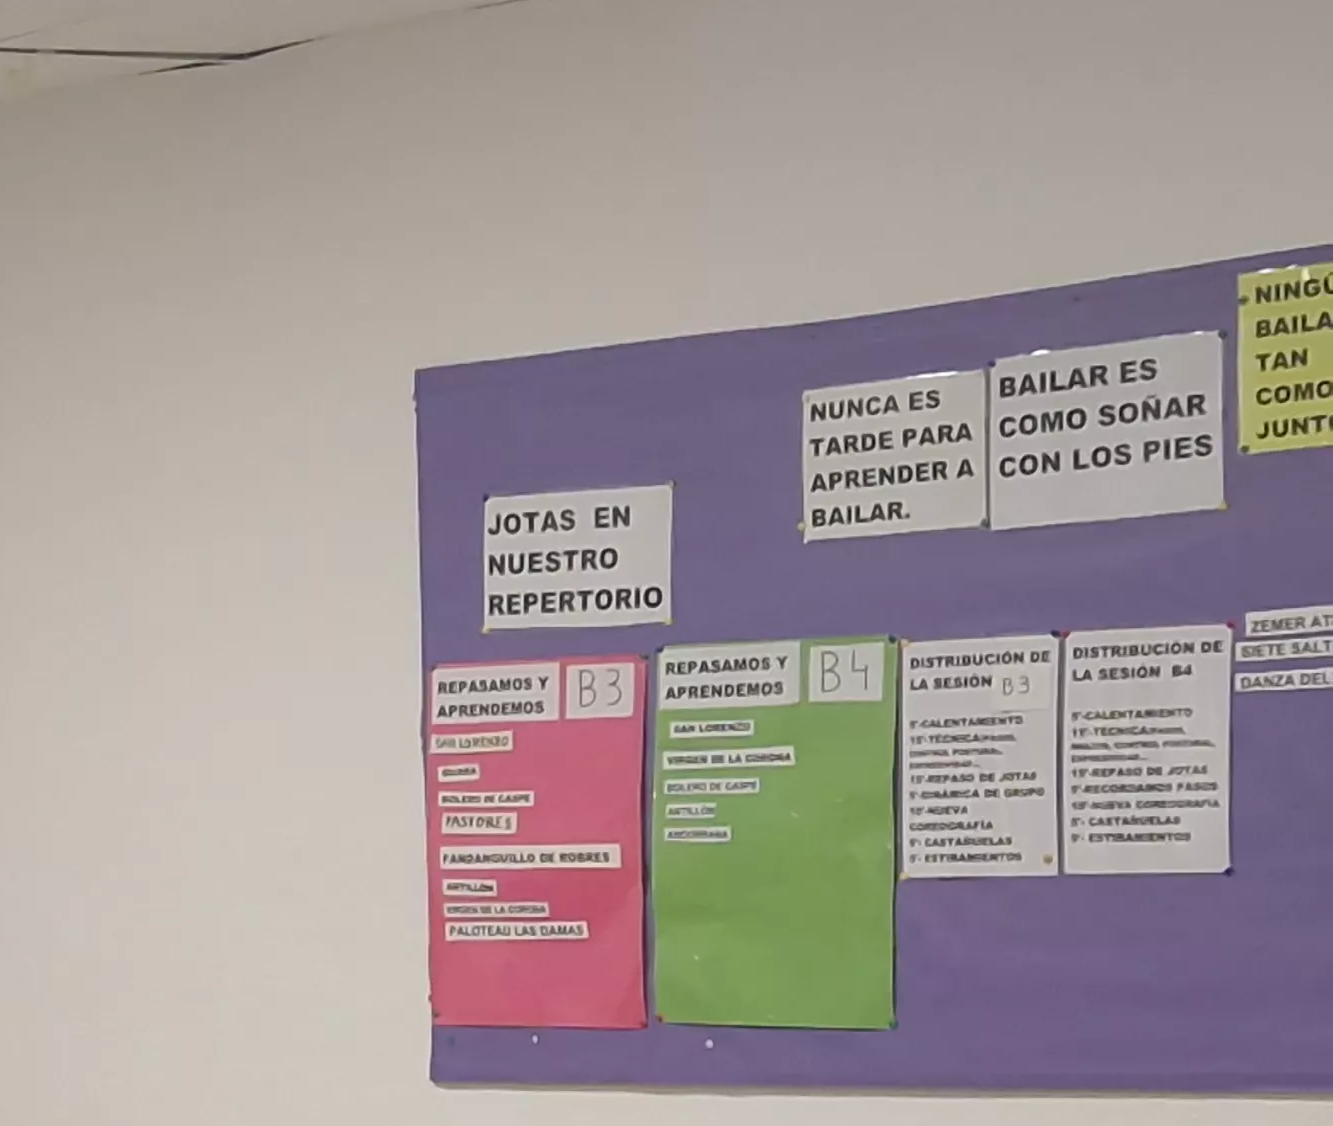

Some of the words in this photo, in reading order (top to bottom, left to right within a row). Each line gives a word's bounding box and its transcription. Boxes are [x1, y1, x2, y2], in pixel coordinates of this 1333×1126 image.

[1255, 348, 1308, 372] TAN
[998, 365, 1107, 398] BAILAR
[1119, 358, 1158, 384] ES
[1255, 380, 1333, 405] COMO
[810, 396, 899, 422] NUNCA
[909, 390, 941, 412] ES
[998, 408, 1087, 438] COMO
[1098, 393, 1206, 427] SOÑAR
[1256, 415, 1333, 439] JUNT
[810, 430, 893, 457] TARDE
[902, 422, 973, 448] PARA
[998, 451, 1061, 478] CON
[1072, 443, 1132, 471] LOS
[1143, 434, 1213, 463] PIES
[810, 460, 948, 493] APRENDER
[956, 458, 974, 478] A
[487, 509, 576, 535] JOTAS
[595, 505, 630, 529] EN
[811, 501, 910, 528] BAILAR.
[489, 548, 618, 575] NUESTRO
[489, 586, 663, 616] REPERTORIO
[910, 651, 1024, 669] DISTRIBUCIÓN
[1031, 650, 1050, 663] DE
[1073, 641, 1194, 659] DISTRIBUCIÓN
[1201, 640, 1224, 653] DE
[665, 657, 770, 675] REPASAMOS
[777, 656, 788, 669] Y
[1073, 669, 1092, 681] LA
[1098, 663, 1160, 680] SESIÓN
[437, 677, 532, 694] REPASAMOS
[538, 676, 549, 690] Y
[665, 681, 784, 700] APRENDEMOS
[910, 679, 928, 690] LA
[934, 673, 993, 689] SESIÓN
[1241, 674, 1294, 689] DANZA
[1300, 672, 1329, 685] DEL
[437, 701, 544, 718] APRENDEMOS
